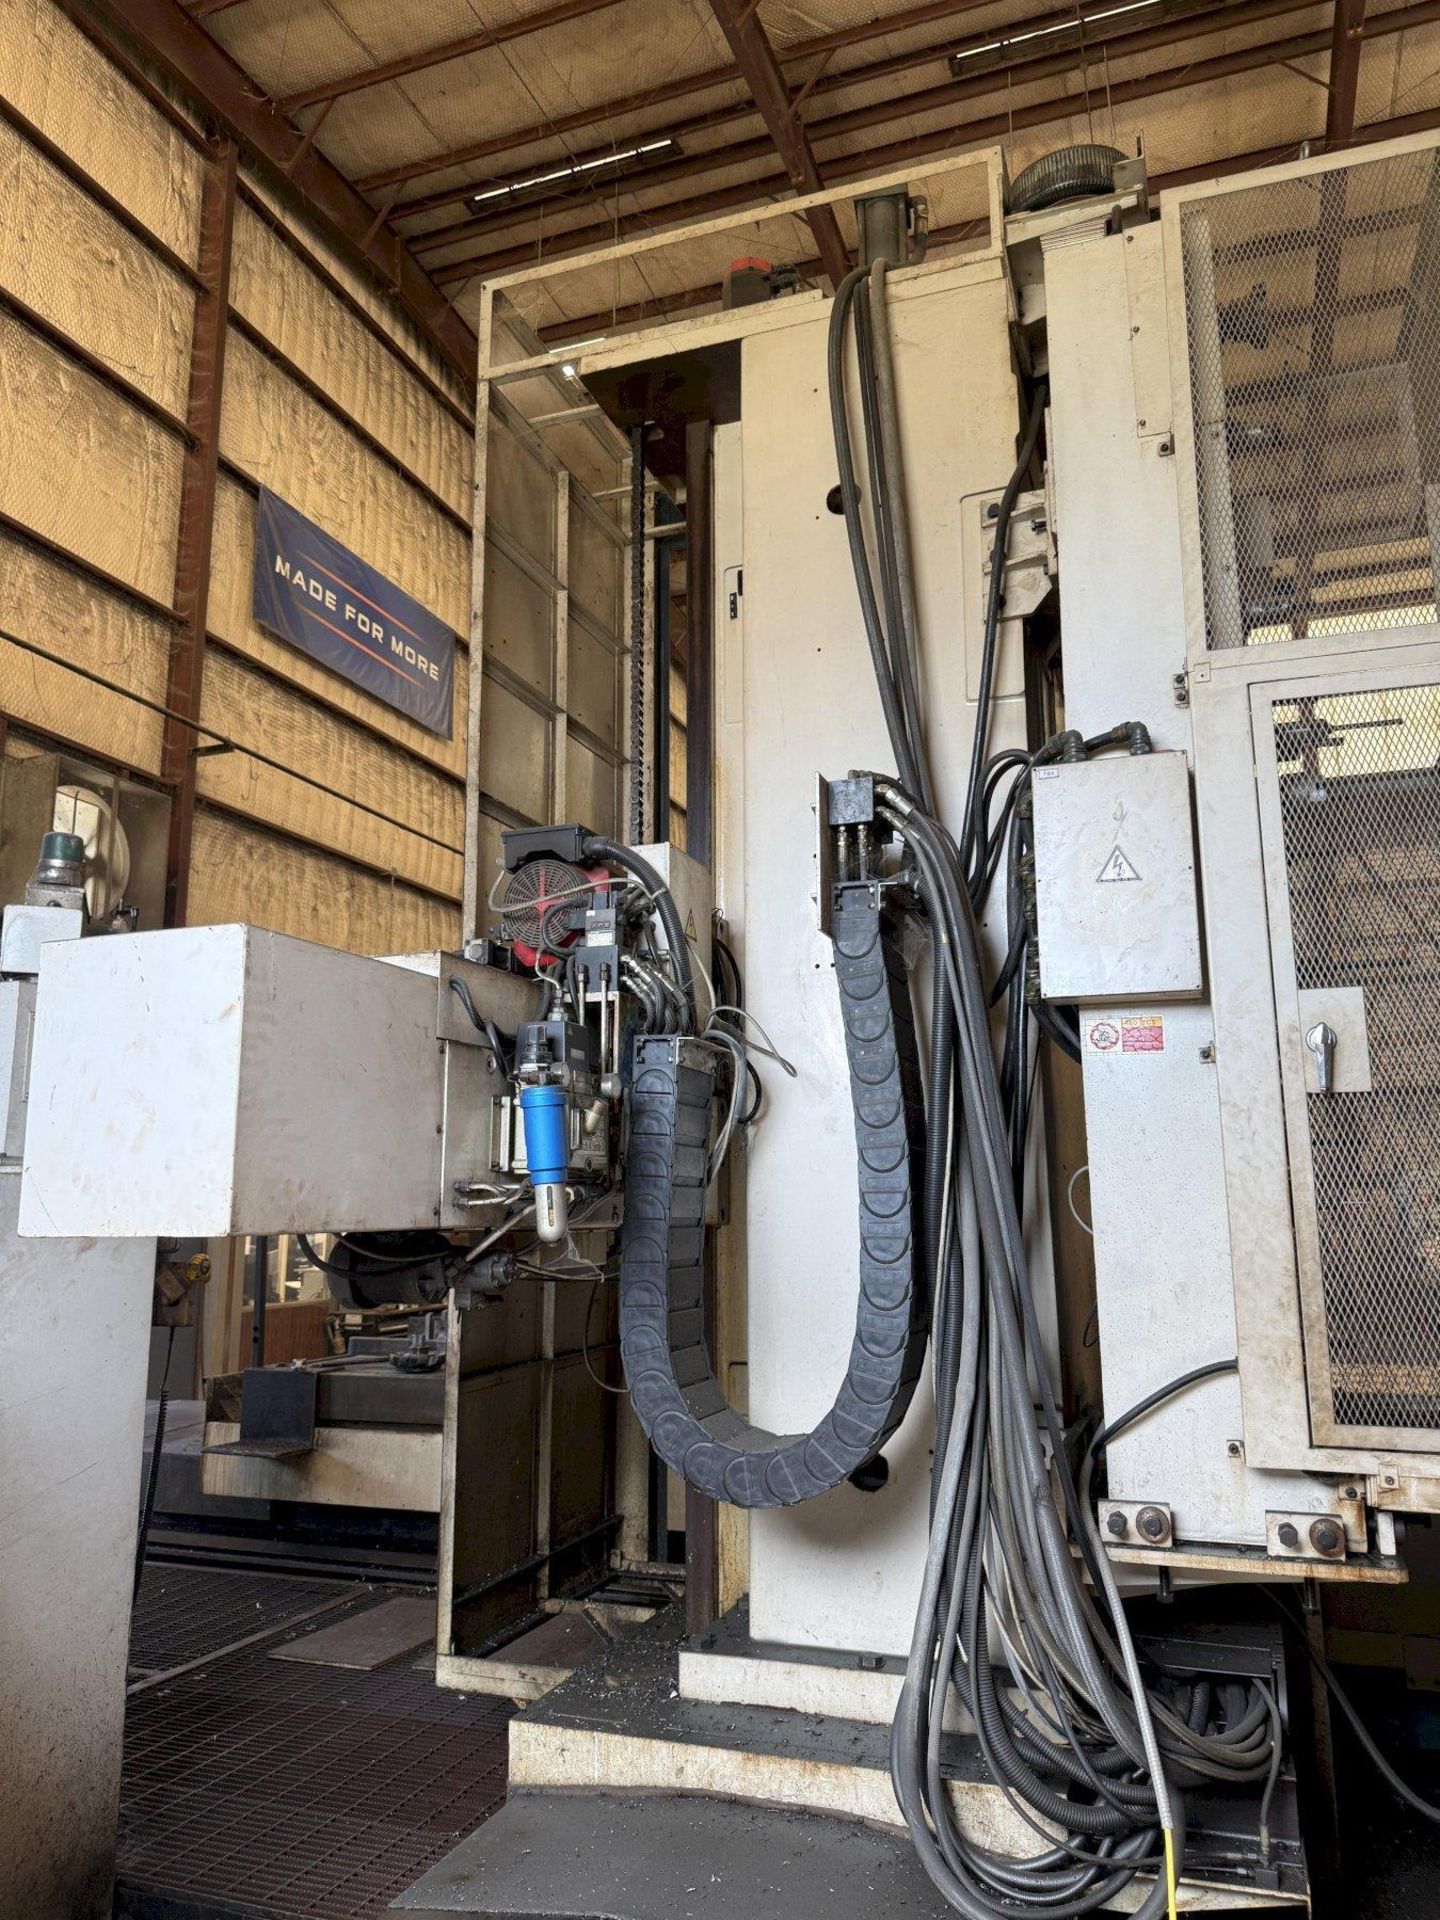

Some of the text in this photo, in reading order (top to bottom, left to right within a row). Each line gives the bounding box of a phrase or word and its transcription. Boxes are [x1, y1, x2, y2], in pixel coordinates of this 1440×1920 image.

[275, 555, 440, 681] MADE FOR MORE
